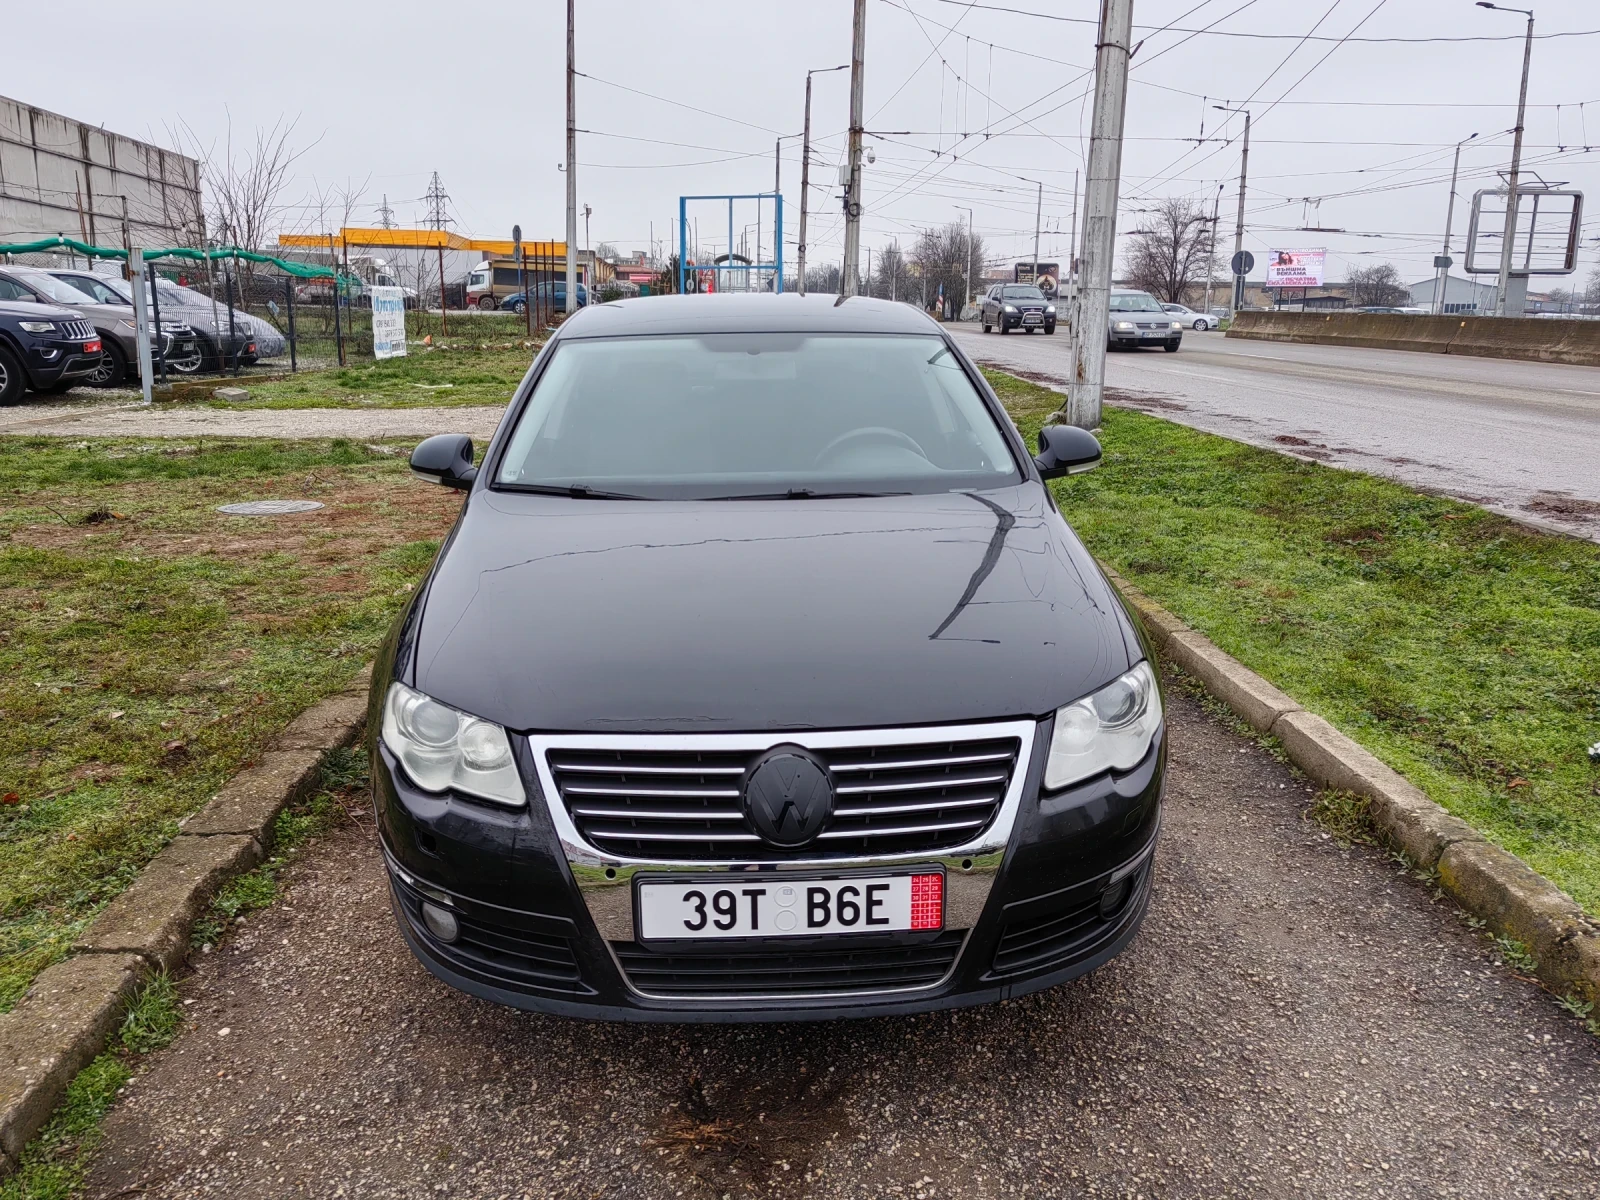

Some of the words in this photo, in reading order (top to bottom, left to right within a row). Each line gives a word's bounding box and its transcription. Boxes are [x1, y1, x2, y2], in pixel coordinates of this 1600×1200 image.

[746, 757, 829, 840] VW
[682, 889, 767, 931] 39T
[807, 884, 890, 928] B6E
